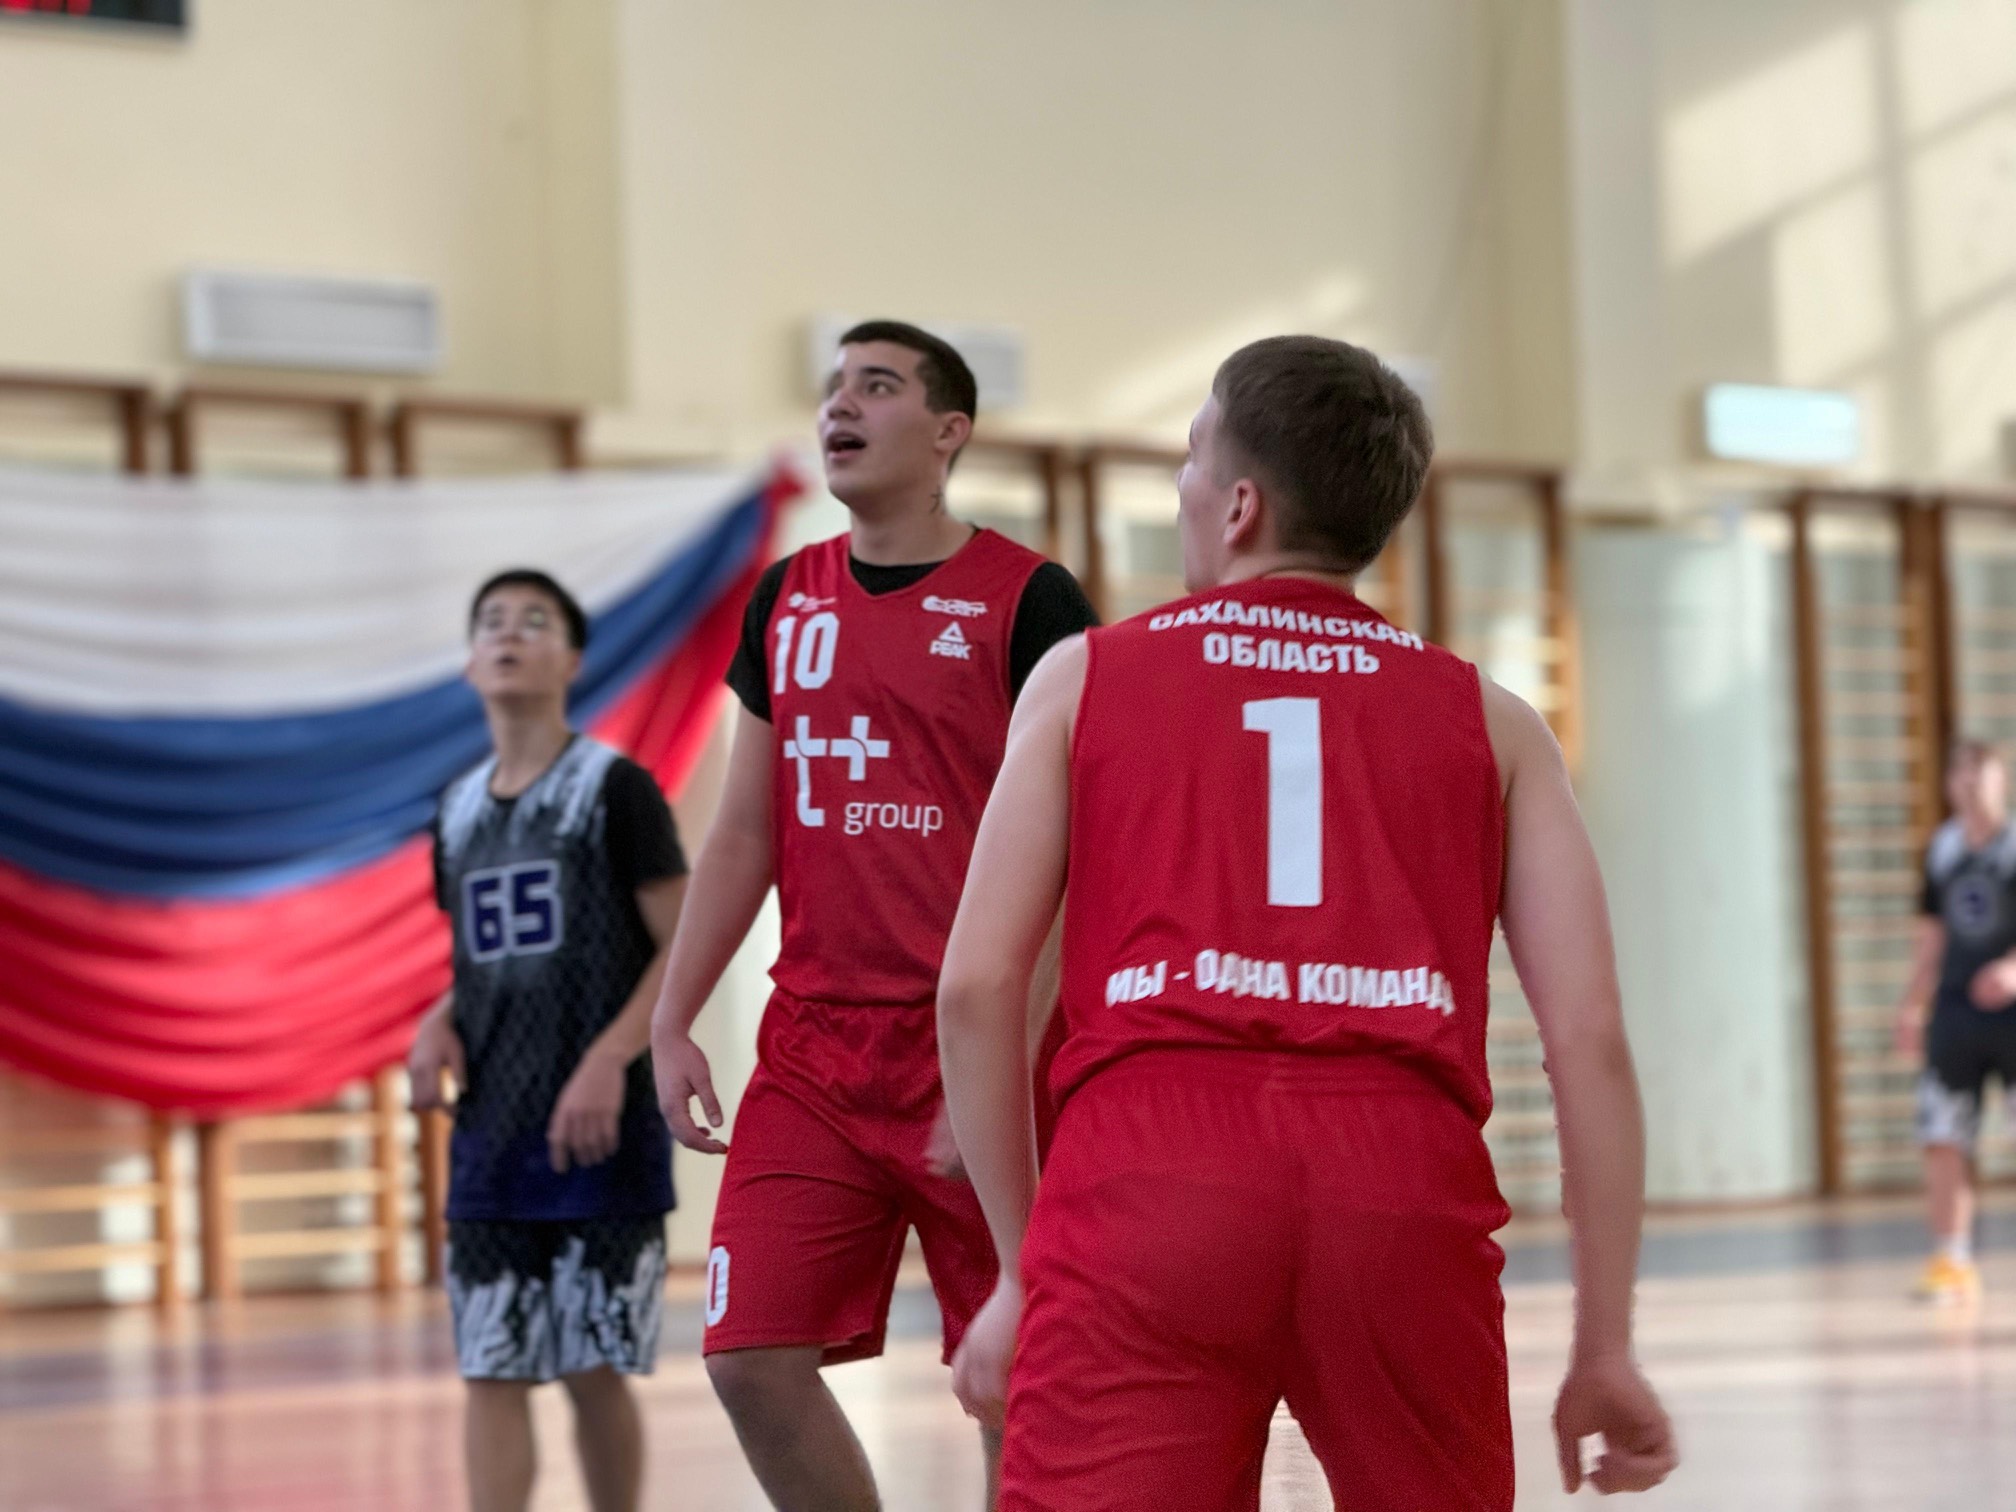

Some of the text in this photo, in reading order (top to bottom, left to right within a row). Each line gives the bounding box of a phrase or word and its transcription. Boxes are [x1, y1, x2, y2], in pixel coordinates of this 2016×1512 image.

[774, 611, 840, 694] 10
[1203, 632, 1380, 674] ОБЛАСТЬ
[844, 802, 943, 837] group
[1242, 697, 1323, 907] 1
[462, 859, 563, 964] 65
[1195, 948, 1291, 1001] ОДНА
